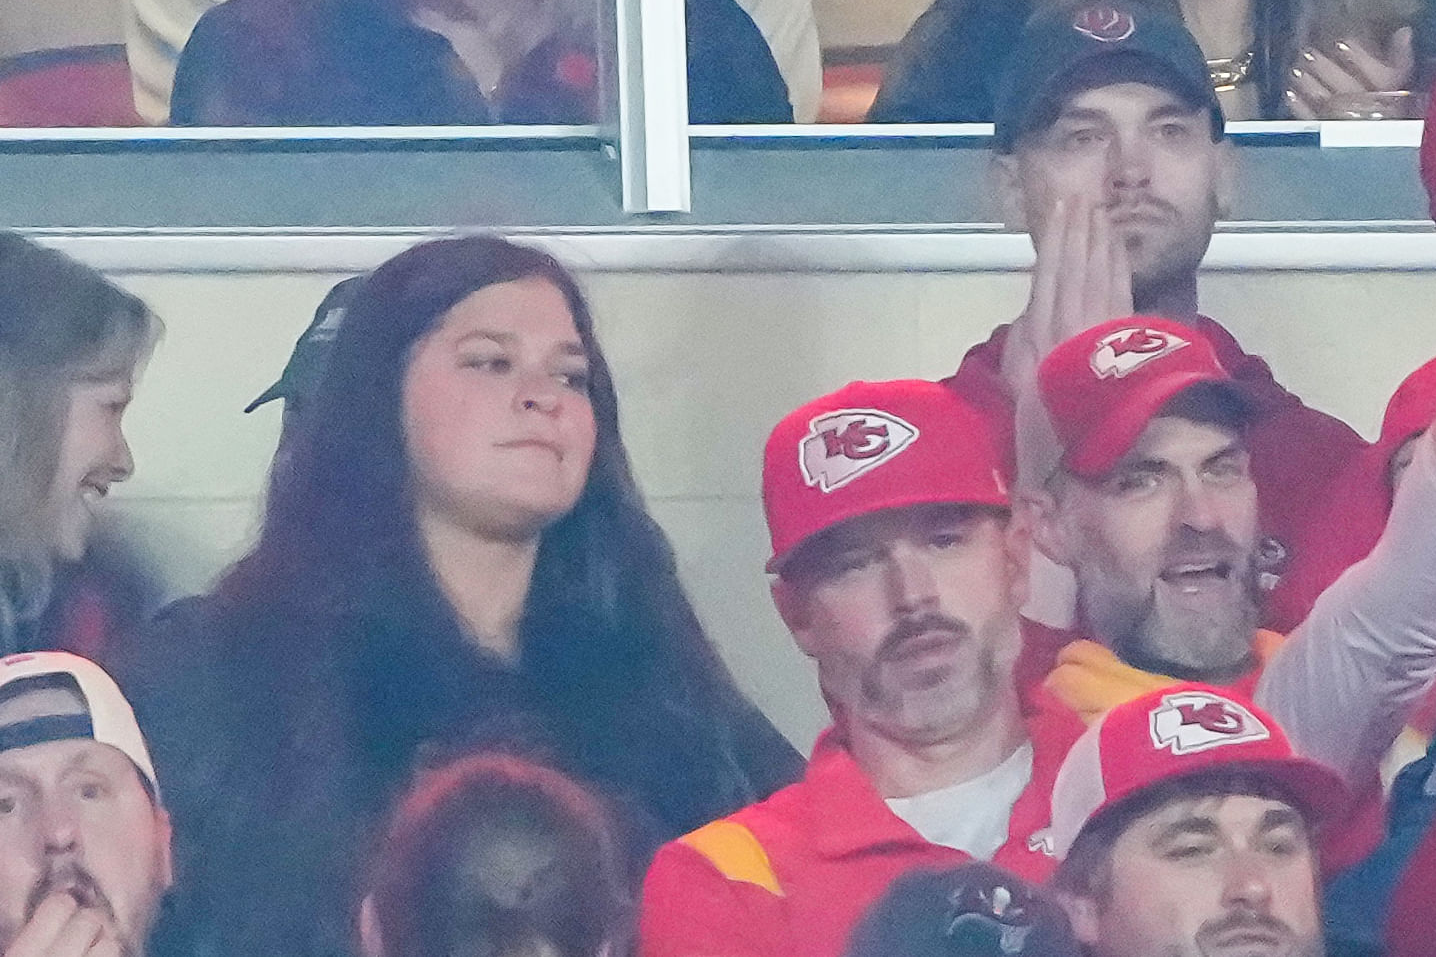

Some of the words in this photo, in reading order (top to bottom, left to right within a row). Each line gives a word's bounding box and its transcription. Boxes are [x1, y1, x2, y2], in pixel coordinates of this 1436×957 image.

[1108, 329, 1168, 357] KC
[821, 419, 890, 460] KC
[1177, 703, 1244, 735] KC
